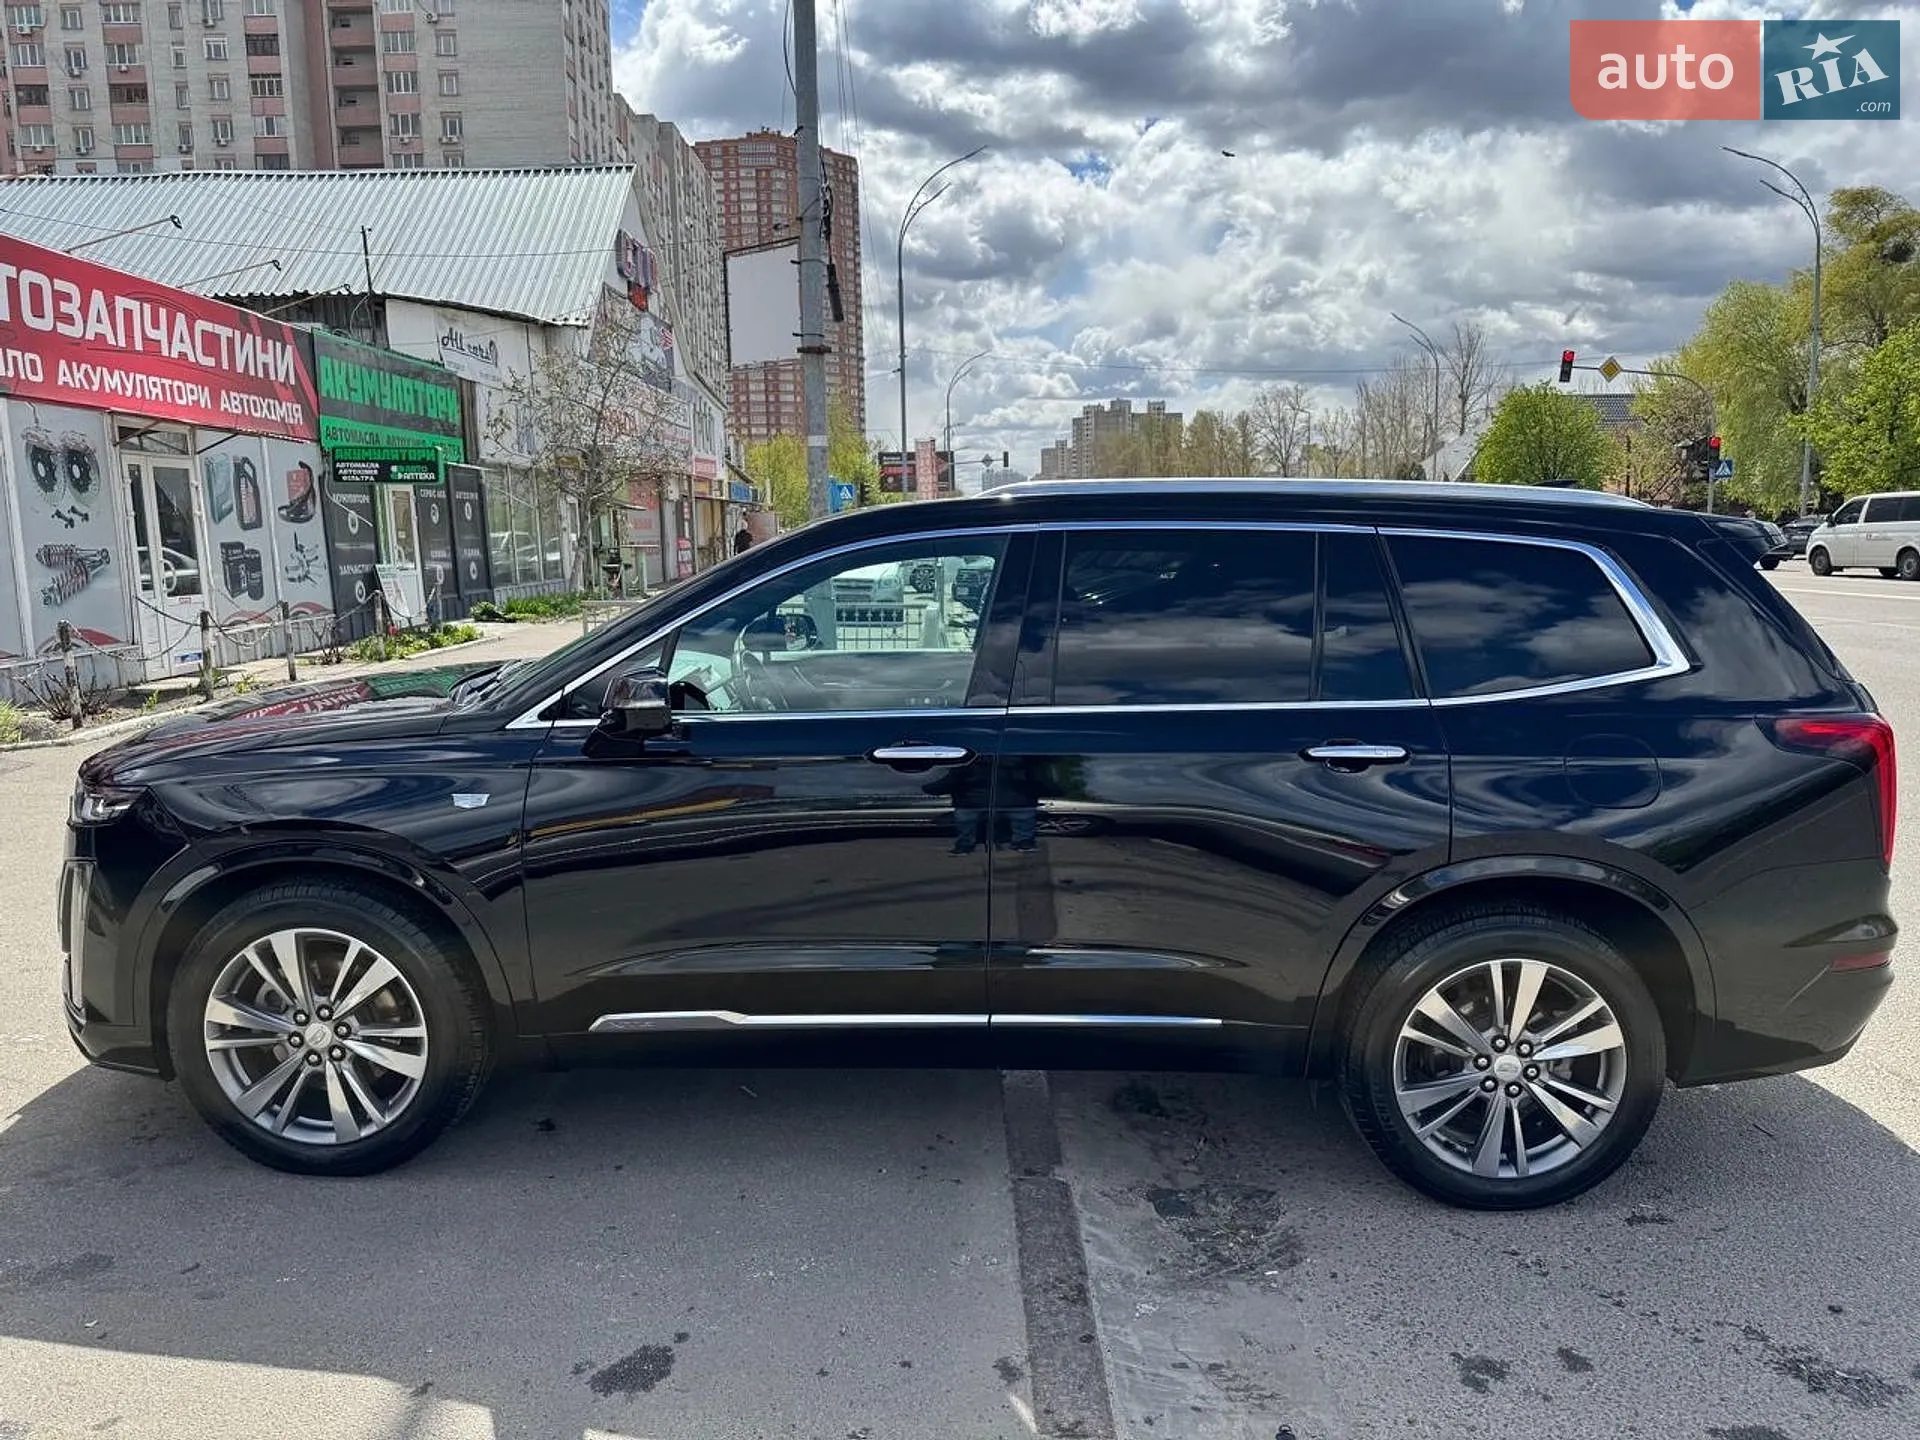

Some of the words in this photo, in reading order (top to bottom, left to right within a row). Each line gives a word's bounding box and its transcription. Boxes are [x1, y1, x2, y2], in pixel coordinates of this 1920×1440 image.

[57, 358, 211, 410] АКУМУЛЯТОРИ
[220, 388, 303, 426] АВТОХІМІЯ
[319, 355, 458, 424] АКУМУЛЯТОРИ
[325, 425, 381, 446] АВТОМАСЛА
